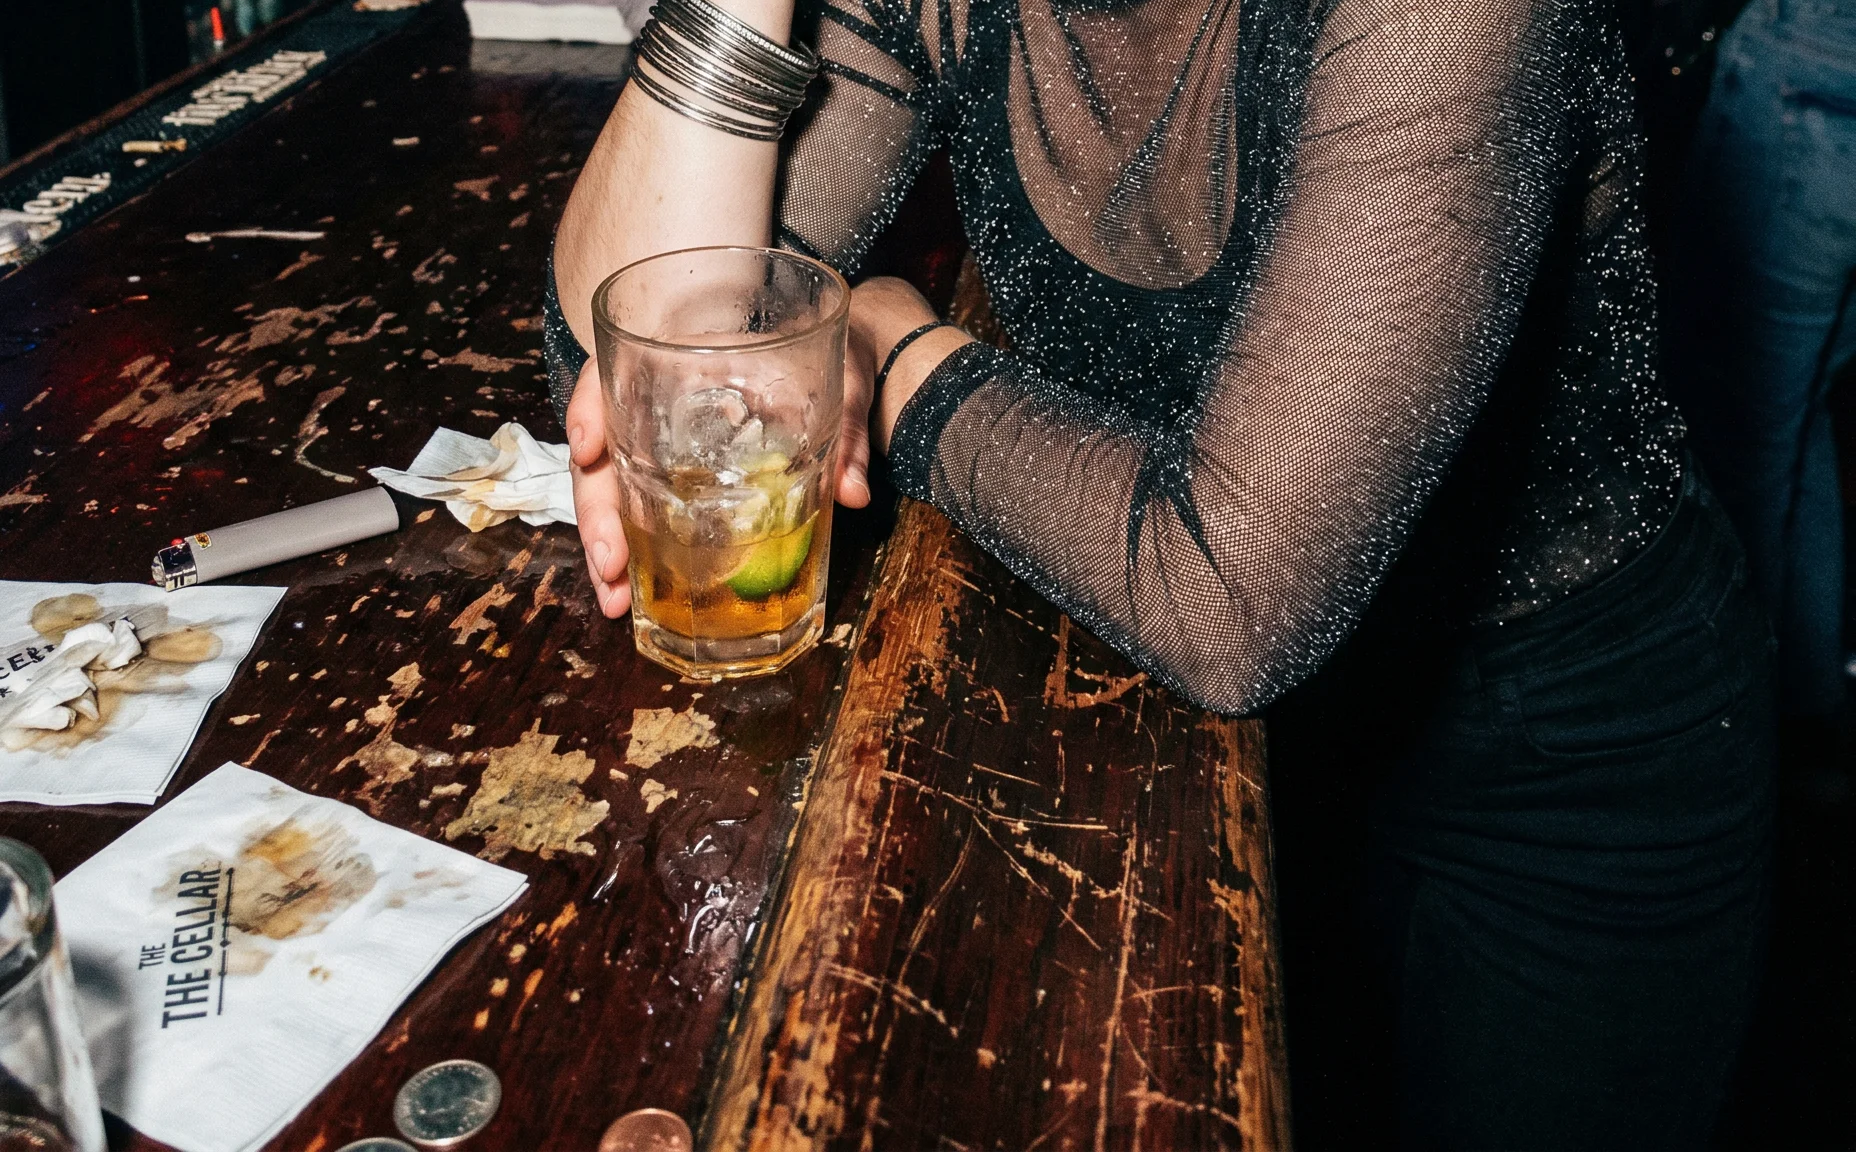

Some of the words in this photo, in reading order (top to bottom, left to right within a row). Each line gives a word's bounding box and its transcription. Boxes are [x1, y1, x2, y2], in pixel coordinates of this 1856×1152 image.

[170, 868, 222, 964] CELLAR
[138, 943, 166, 970] THE
[161, 968, 212, 1029] THE
